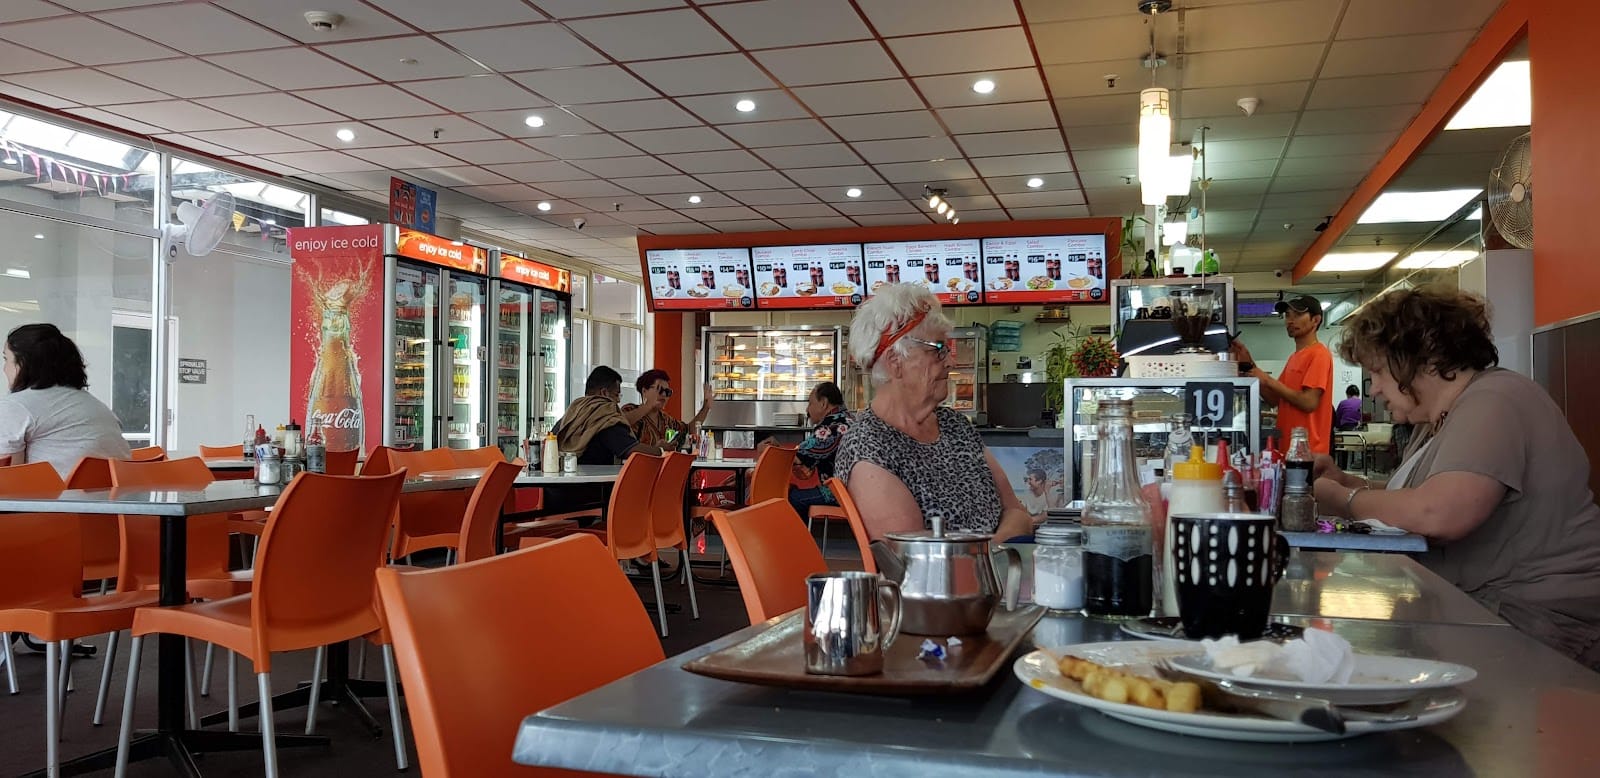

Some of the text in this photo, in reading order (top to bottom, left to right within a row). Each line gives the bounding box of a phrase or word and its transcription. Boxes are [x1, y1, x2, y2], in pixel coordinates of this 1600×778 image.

[295, 235, 378, 252] enjoy ice cold
[418, 242, 462, 260] enjoy ice cold
[515, 265, 550, 281] enjoy ice cold
[1193, 389, 1225, 421] 19
